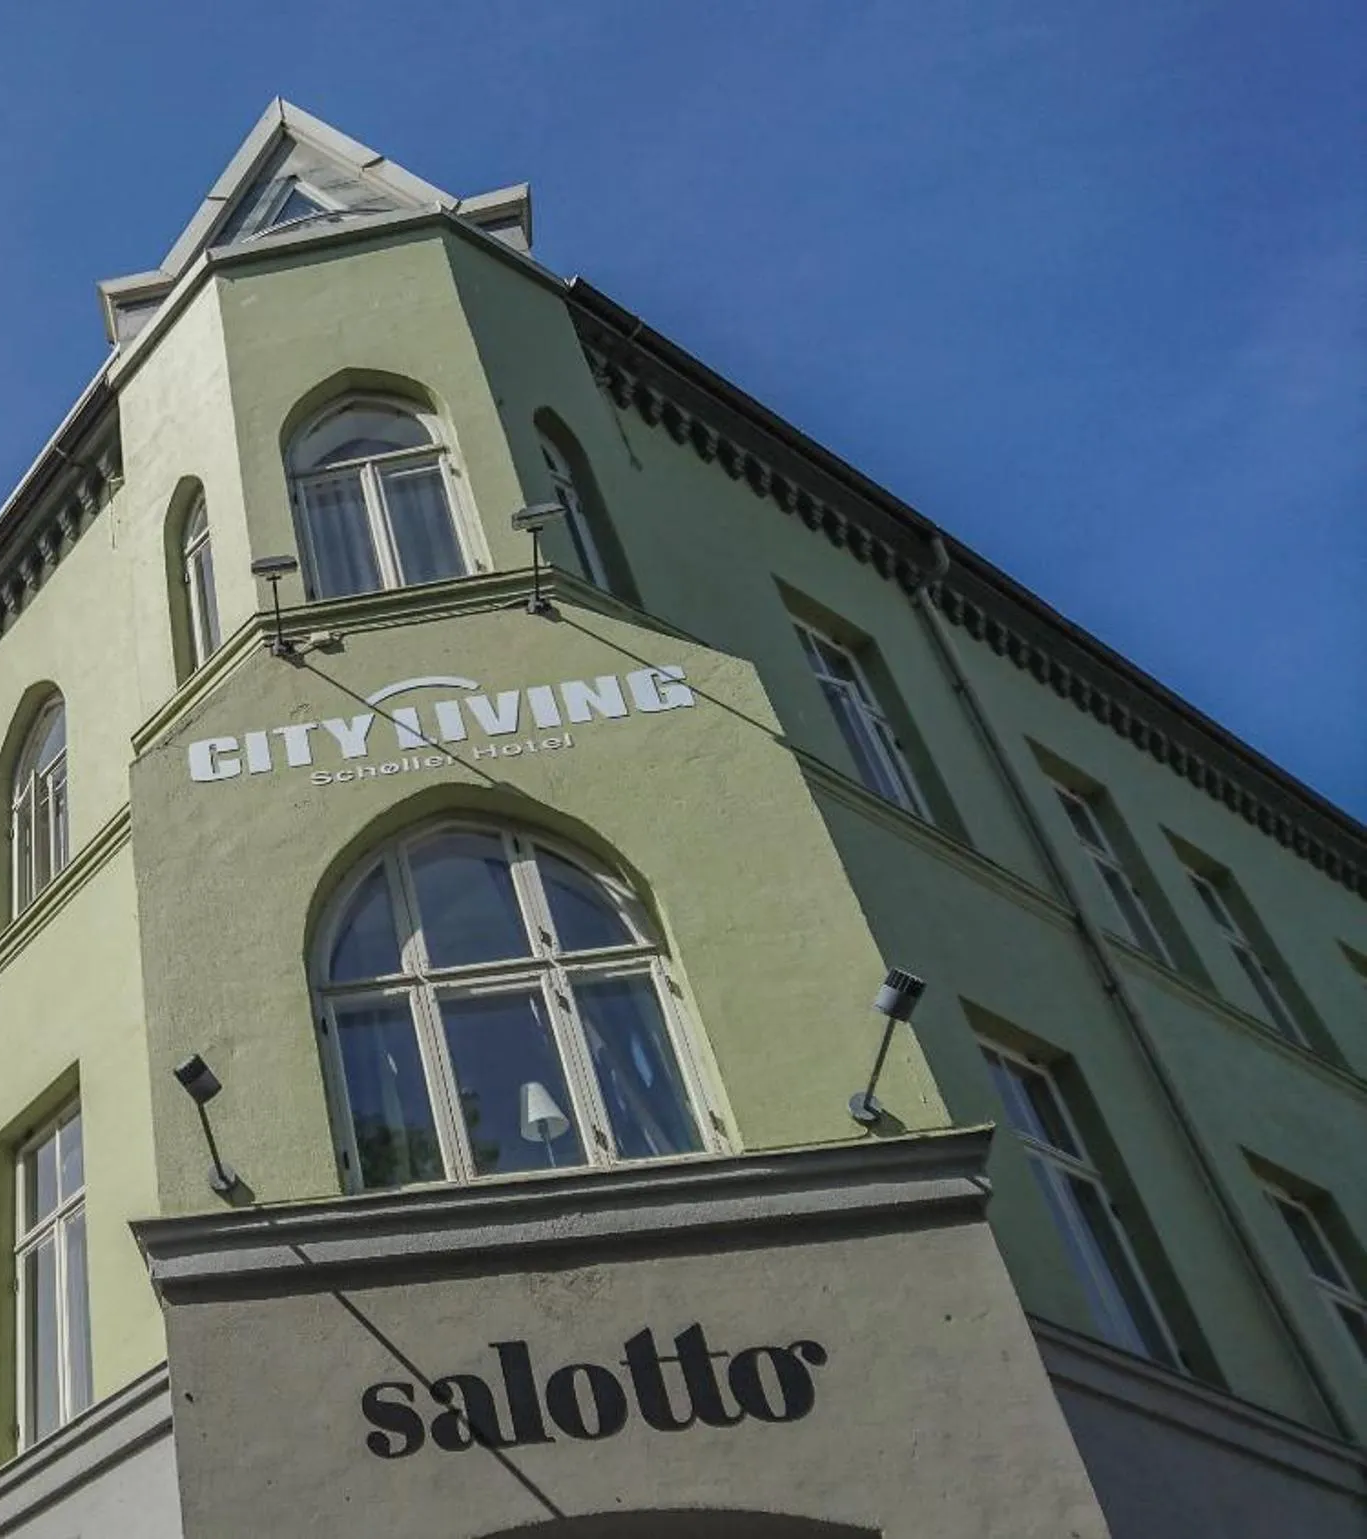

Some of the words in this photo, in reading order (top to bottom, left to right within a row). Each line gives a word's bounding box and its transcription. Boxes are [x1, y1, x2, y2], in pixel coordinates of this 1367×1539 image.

[188, 713, 376, 782] CITY
[392, 666, 696, 749] LIVING
[310, 754, 454, 786] Schøller
[472, 733, 574, 760] Hotel
[361, 1322, 828, 1459] salotto
